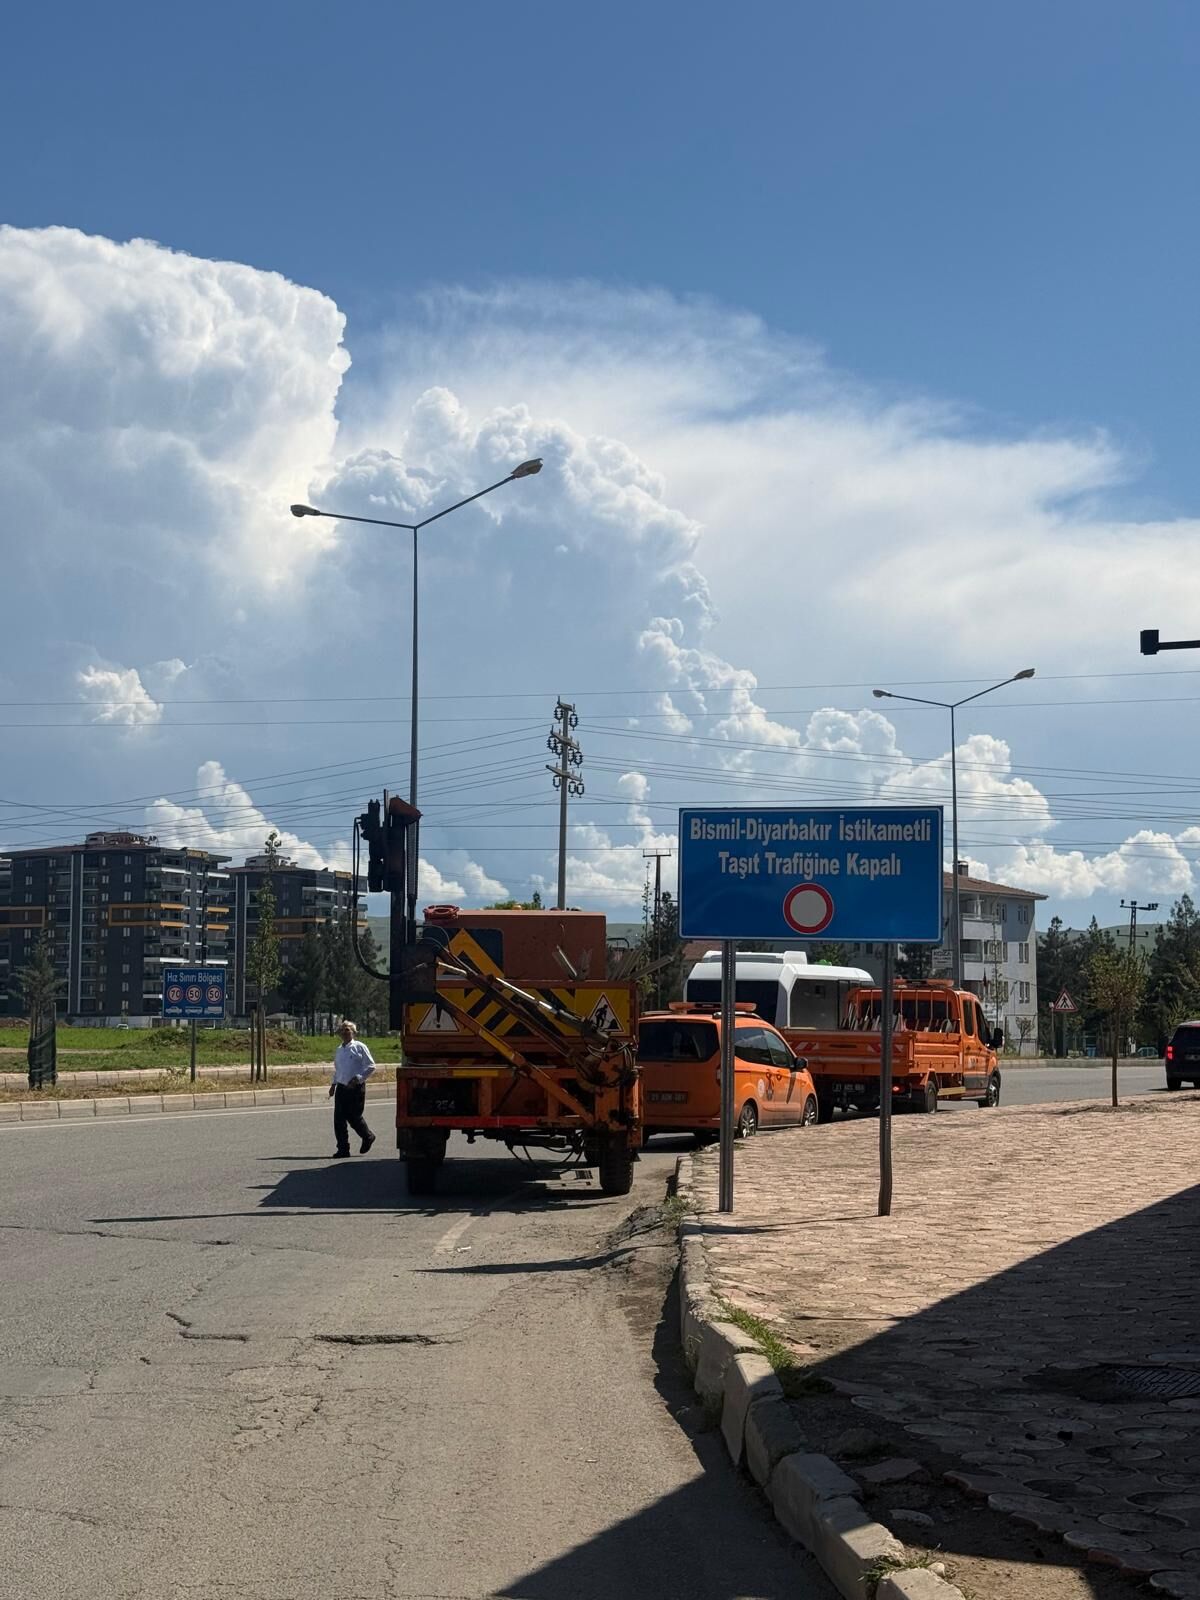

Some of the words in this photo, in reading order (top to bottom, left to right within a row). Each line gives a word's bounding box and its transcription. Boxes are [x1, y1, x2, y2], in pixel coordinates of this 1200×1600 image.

[690, 817, 832, 846] Bismil-Diyarbakır
[839, 814, 931, 842] İstikametli
[718, 851, 760, 879] Taşıt
[764, 852, 840, 880] Trafiğine
[846, 853, 901, 881] Kapalı
[167, 972, 178, 982] Hız
[179, 972, 197, 982] Sınırı
[198, 972, 223, 984] Bölgesi
[171, 990, 181, 998] 70
[189, 990, 199, 998] 50
[209, 990, 220, 999] 50
